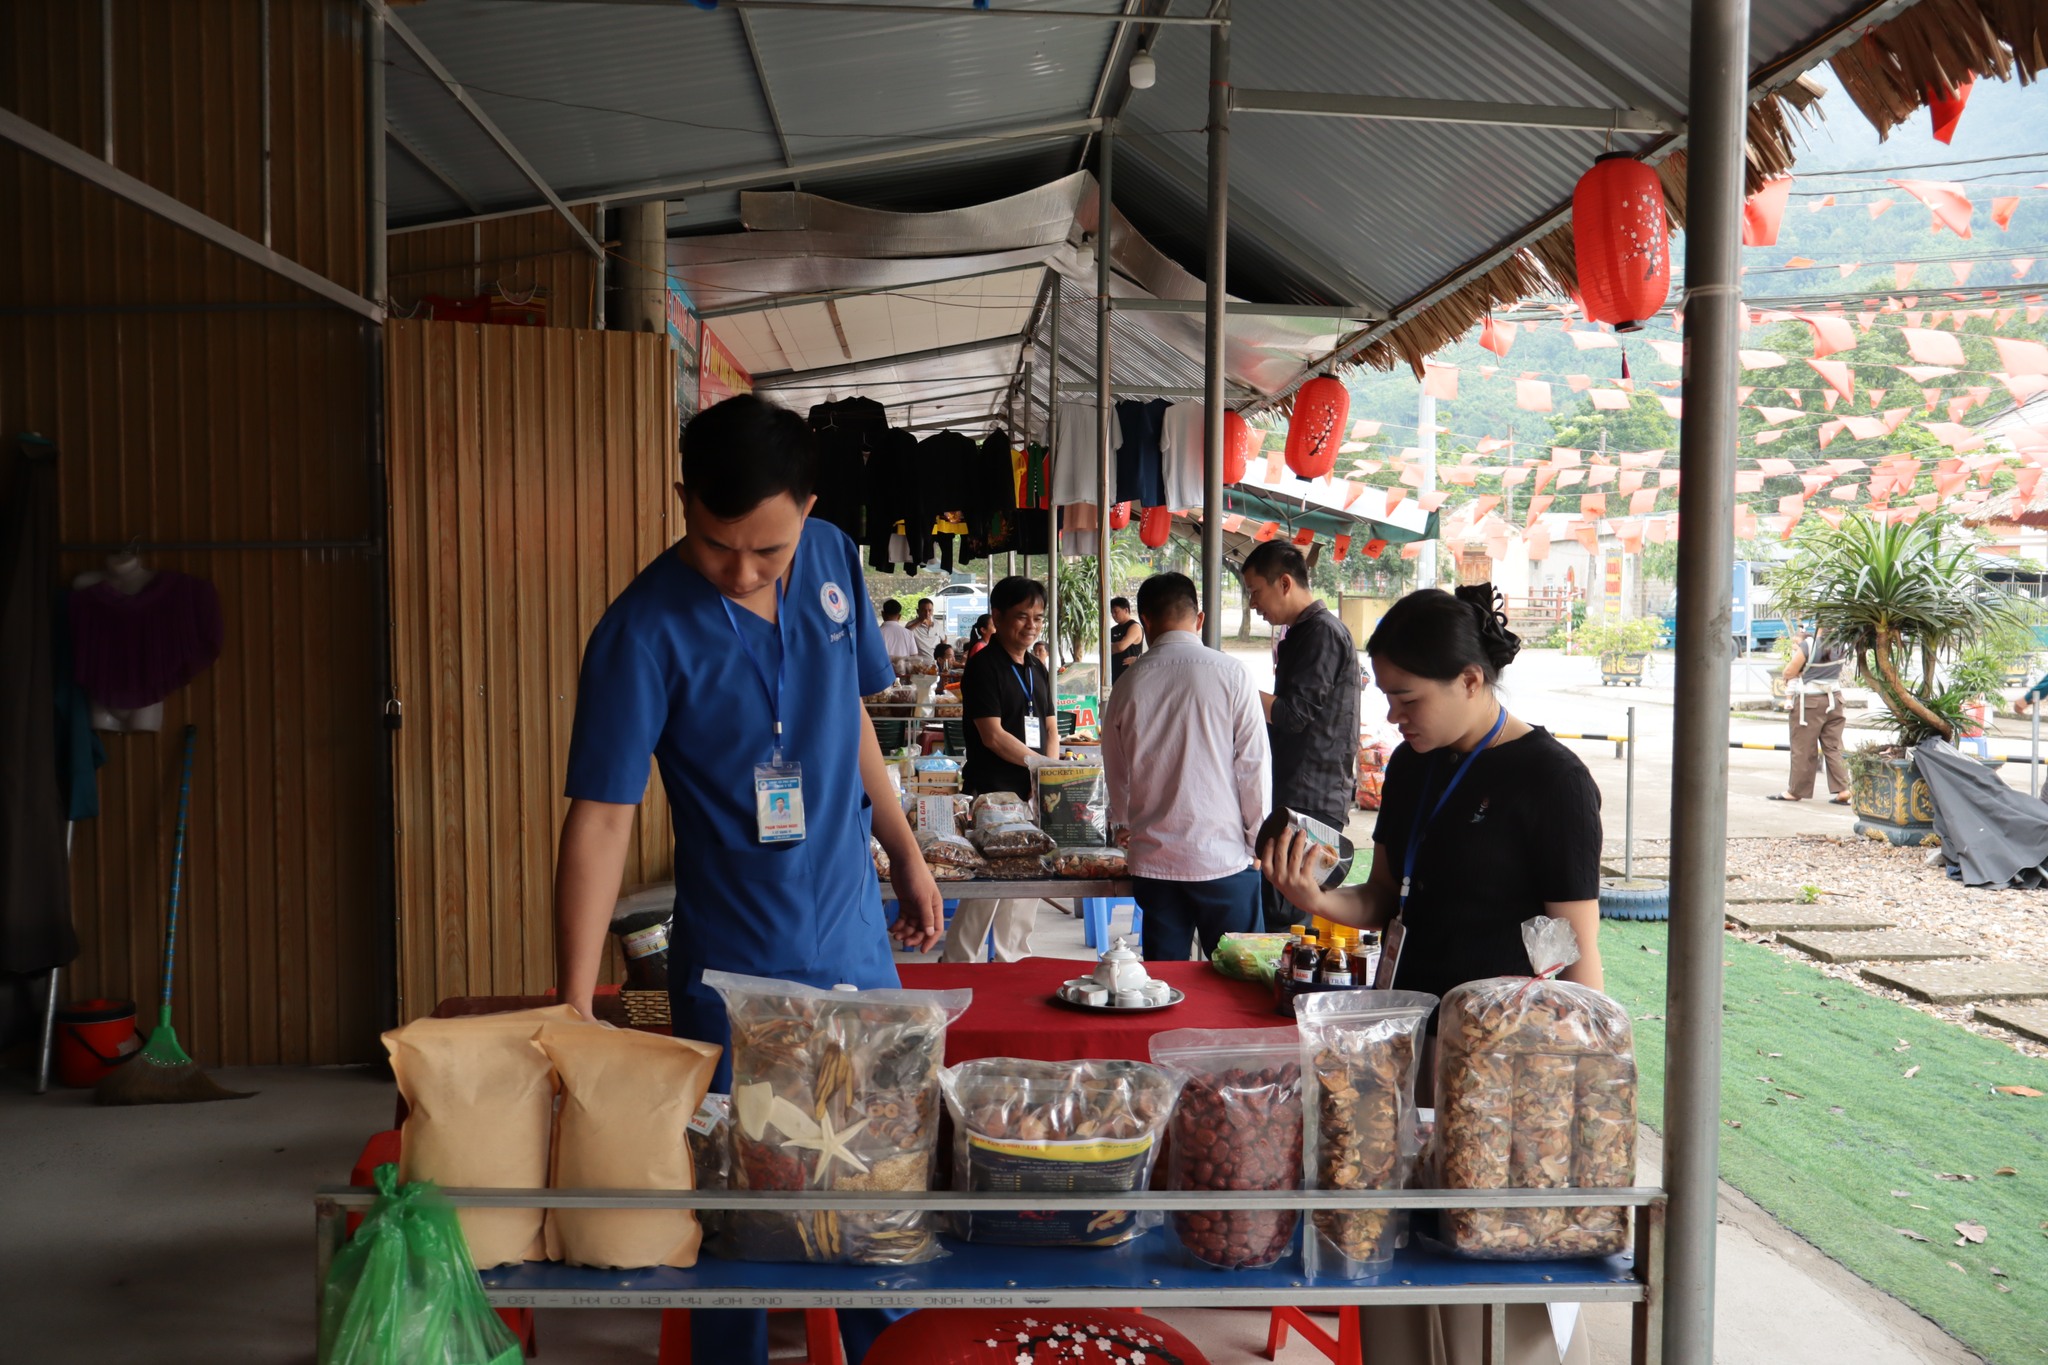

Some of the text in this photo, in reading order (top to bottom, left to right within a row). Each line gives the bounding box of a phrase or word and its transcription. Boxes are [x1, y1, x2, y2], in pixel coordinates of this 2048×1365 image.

[507, 1296, 536, 1306] ISO
[571, 1296, 601, 1306] KHI
[610, 1296, 631, 1306] CO
[640, 1296, 671, 1306] KEM
[681, 1296, 701, 1306] MA
[712, 1296, 742, 1306] HOP
[752, 1296, 782, 1306] ONG
[812, 1296, 853, 1306] PIPE
[863, 1296, 914, 1306] STEEL
[924, 1296, 963, 1306] HONG
[973, 1296, 1013, 1306] KHOA
